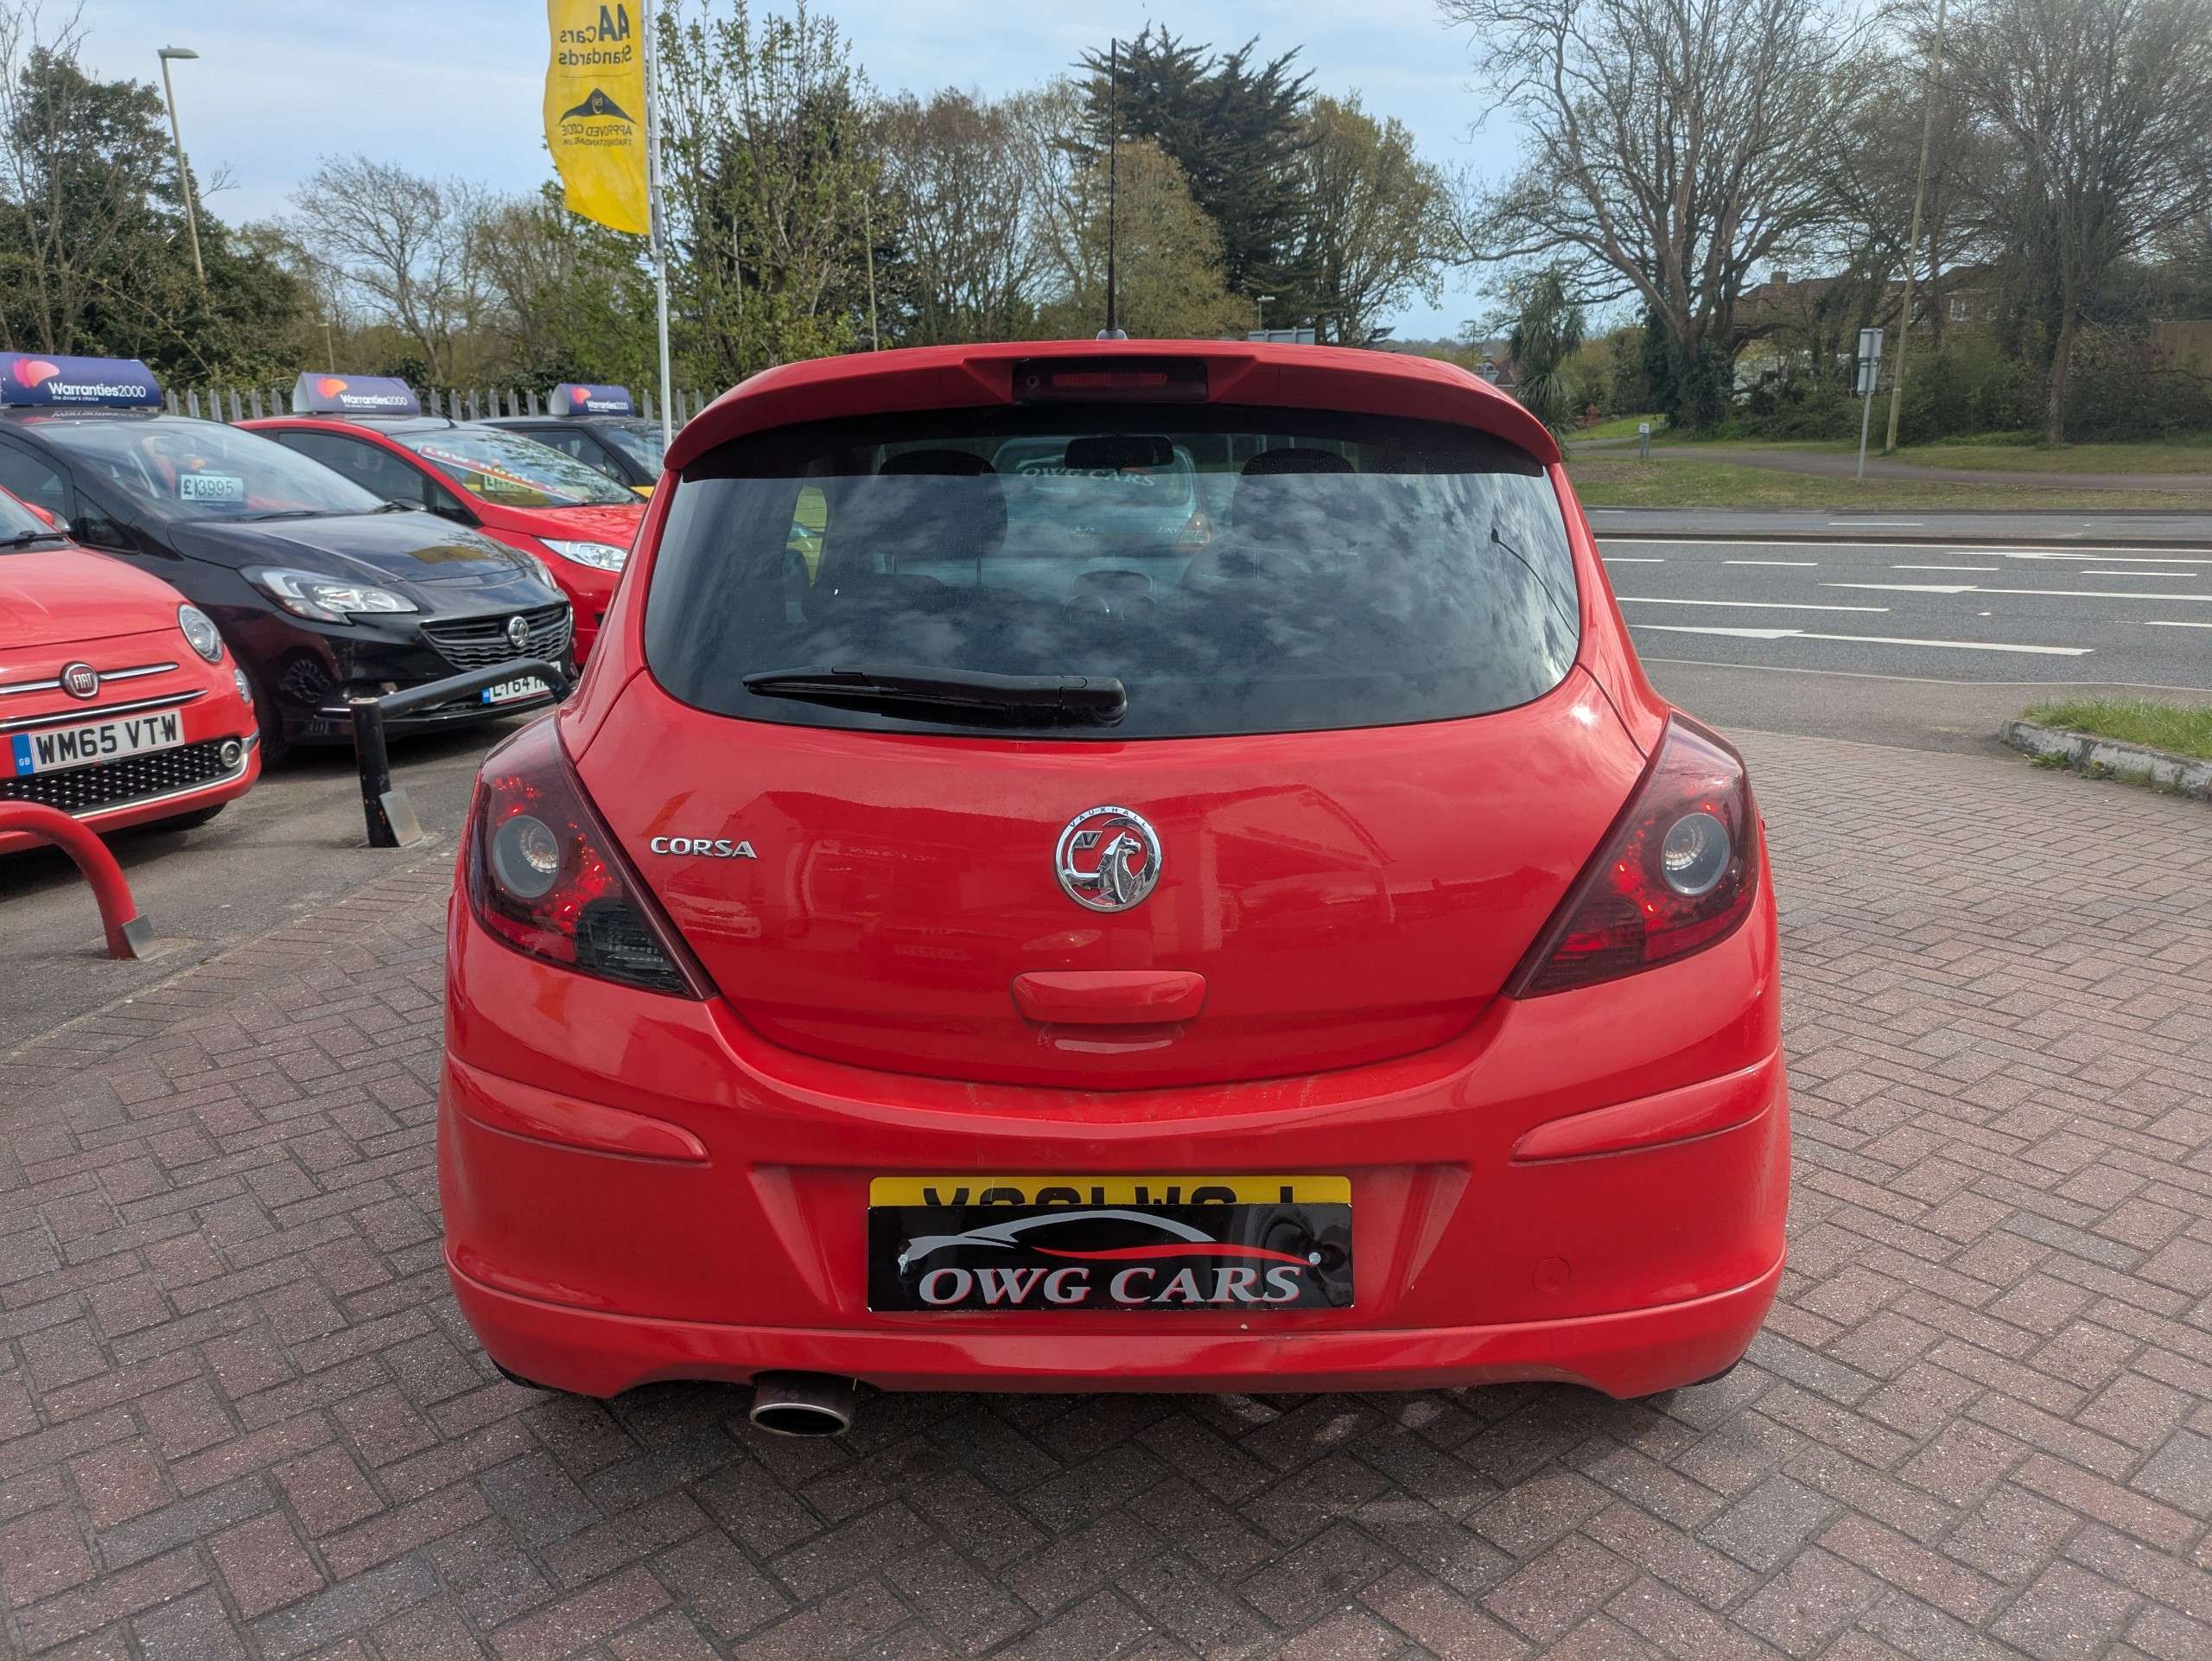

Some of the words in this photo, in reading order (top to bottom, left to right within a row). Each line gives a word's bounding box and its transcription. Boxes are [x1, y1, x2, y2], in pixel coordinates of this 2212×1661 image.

[48, 382, 147, 398] Warranties2000
[340, 393, 408, 406] Warranties2000
[73, 673, 92, 690] FIAT
[35, 725, 118, 765] WM65
[124, 714, 177, 748] VTW
[18, 758, 31, 767] GB
[1069, 806, 1147, 829] VAUXHALL
[651, 837, 758, 859] CORSA
[918, 1267, 1091, 1305] OWG
[1109, 1265, 1302, 1305] CARS
